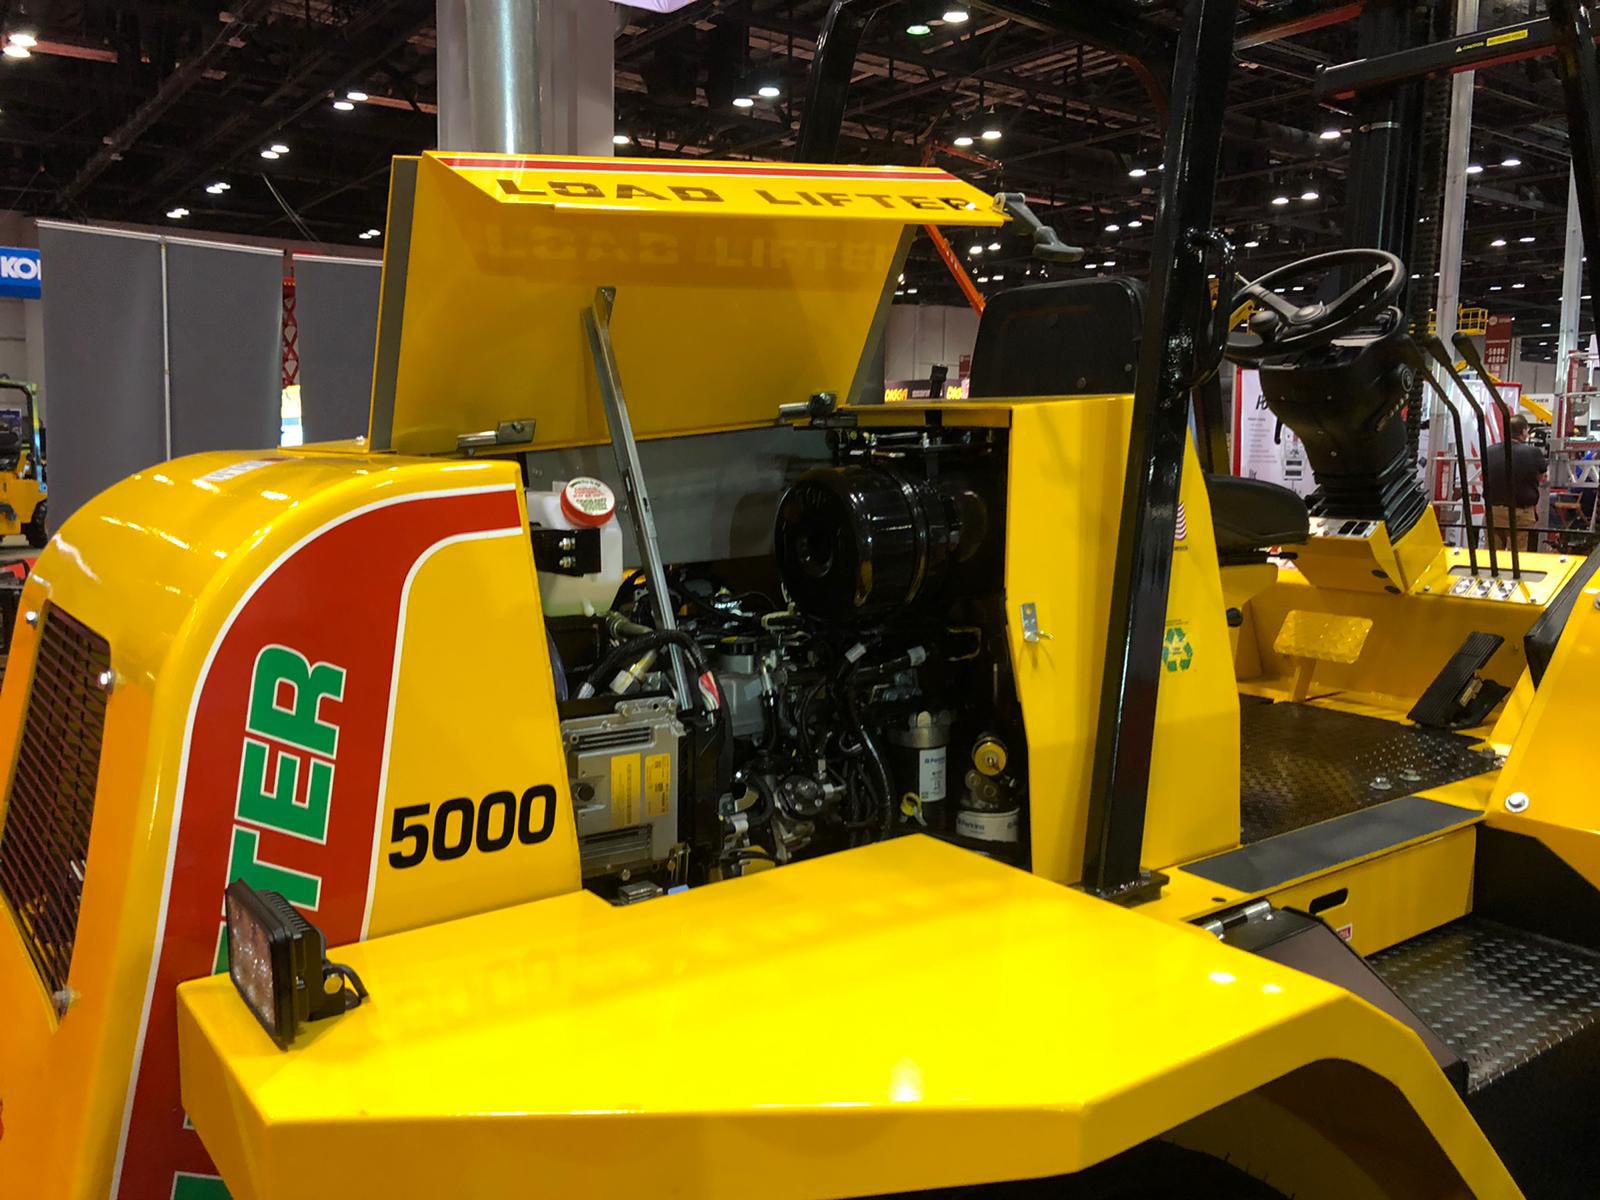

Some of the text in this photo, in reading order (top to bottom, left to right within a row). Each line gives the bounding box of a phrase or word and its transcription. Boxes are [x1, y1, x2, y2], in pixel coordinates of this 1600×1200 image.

[496, 179, 982, 212] LOAD LIFTER
[389, 784, 556, 869] 5000
